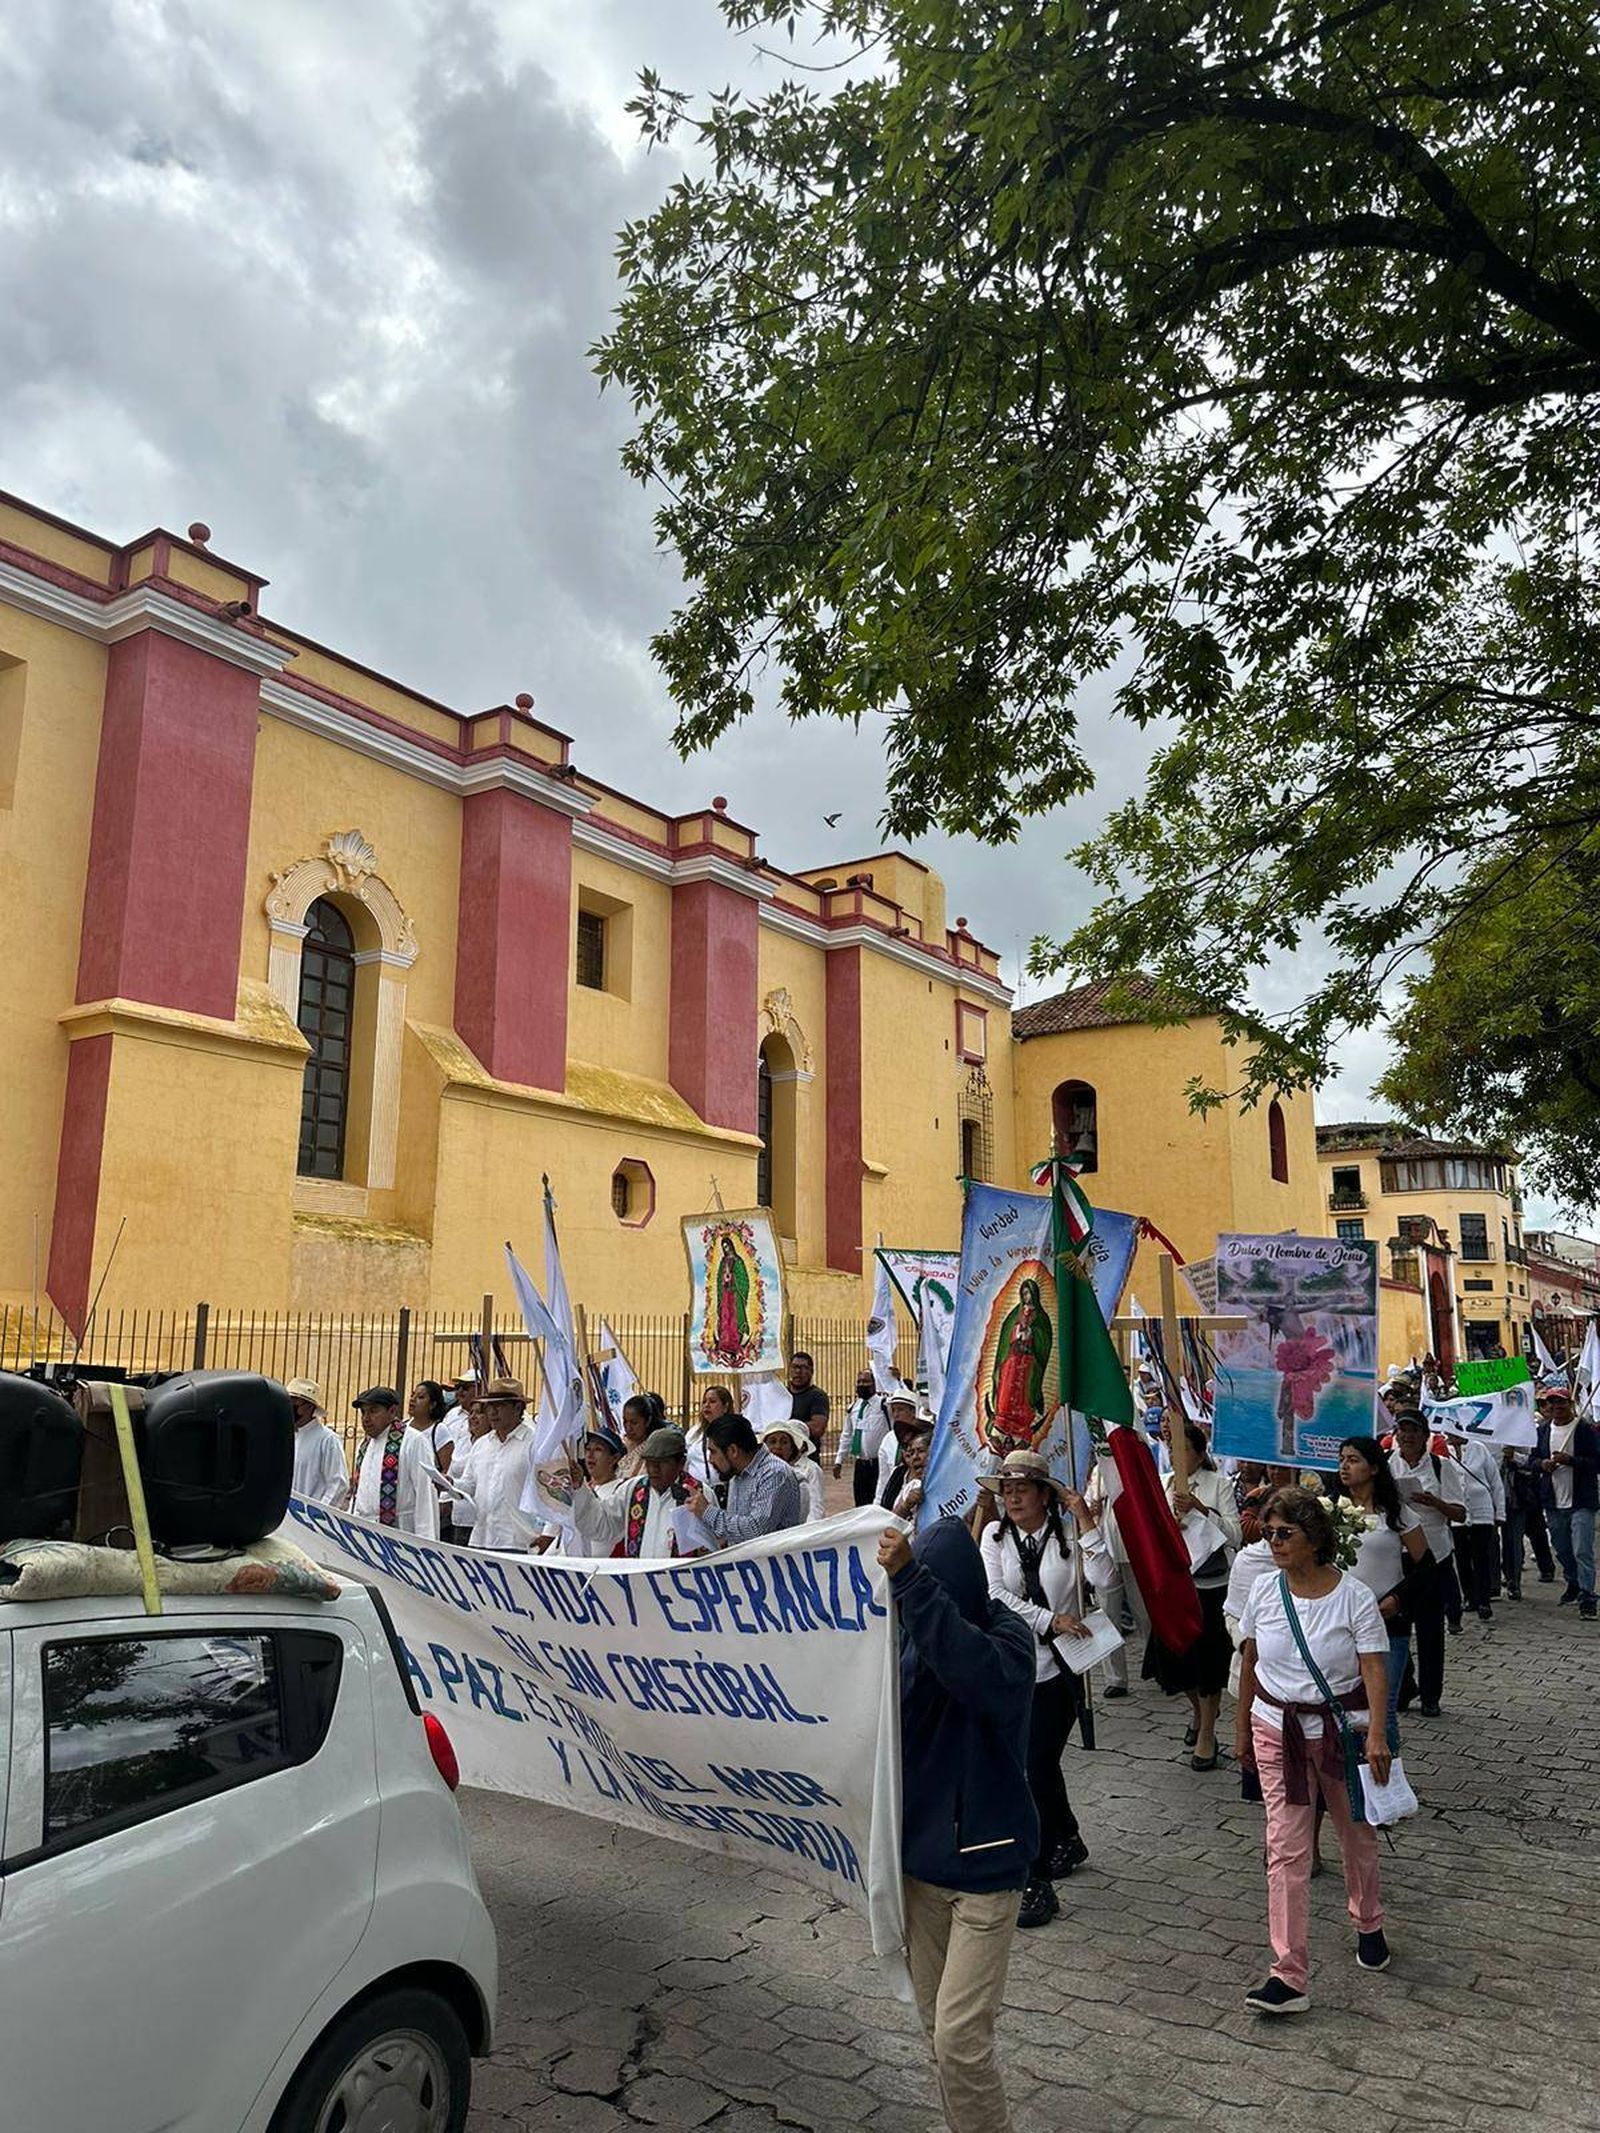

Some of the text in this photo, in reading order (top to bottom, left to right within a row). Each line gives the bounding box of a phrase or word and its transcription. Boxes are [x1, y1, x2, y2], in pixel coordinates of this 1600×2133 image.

[979, 1204, 1019, 1240] Verdad
[1228, 1242, 1262, 1258] Dulce
[1266, 1243, 1313, 1259] Nombre
[1315, 1247, 1329, 1259] de
[938, 1488, 968, 1517] Amor
[451, 1554, 535, 1622] PAZ,
[516, 1565, 616, 1627] VIDA
[614, 1573, 639, 1627] Y
[645, 1545, 888, 1634] ESPERANZA
[492, 1625, 554, 1679] EN
[538, 1640, 617, 1703] SAN
[511, 1672, 563, 1728] ES
[623, 1751, 718, 1794] DEL
[707, 1763, 842, 1807] AMOR
[546, 1736, 572, 1787] Y
[577, 1748, 634, 1806] LA
